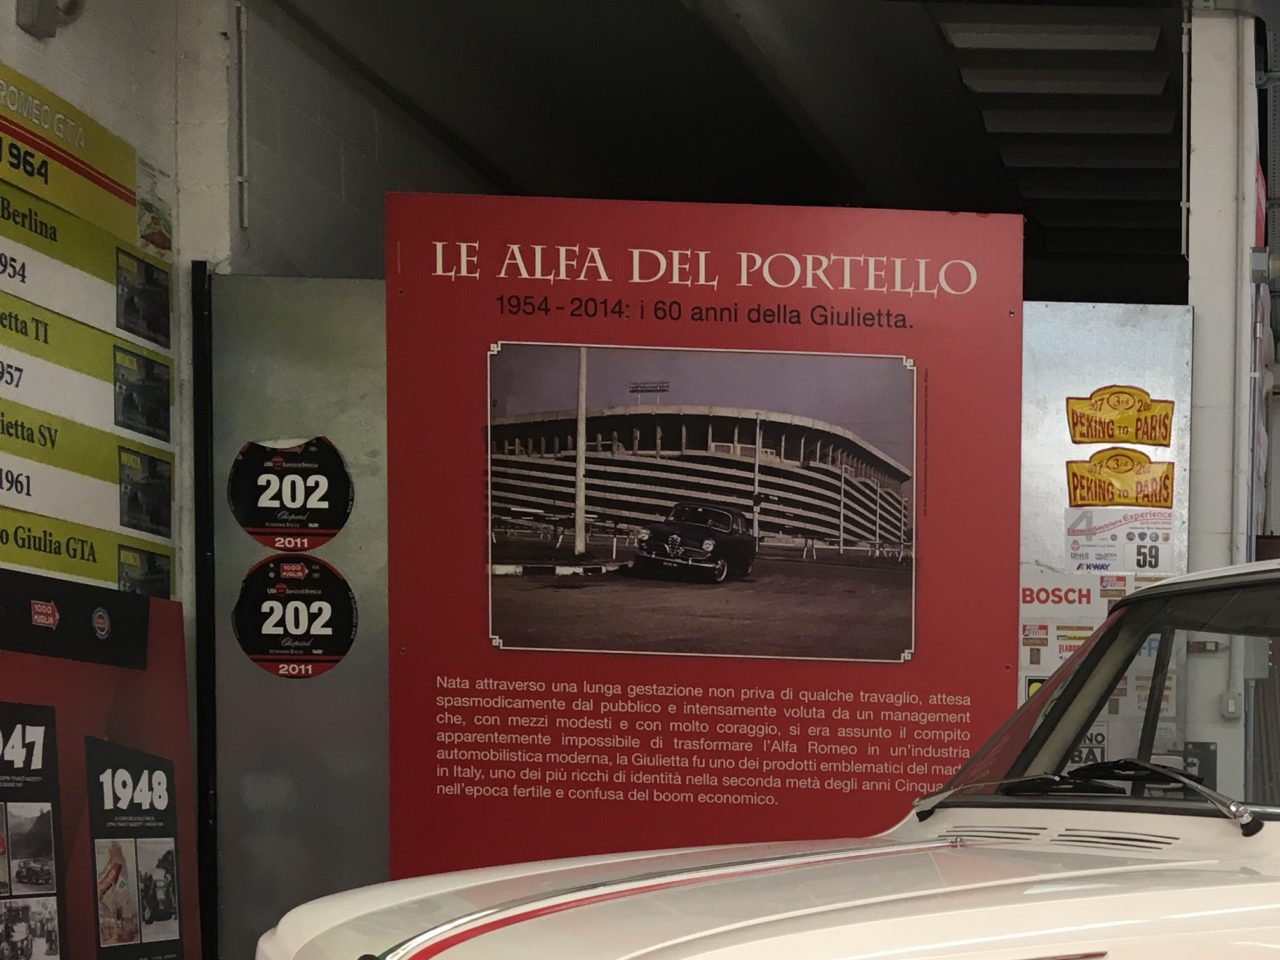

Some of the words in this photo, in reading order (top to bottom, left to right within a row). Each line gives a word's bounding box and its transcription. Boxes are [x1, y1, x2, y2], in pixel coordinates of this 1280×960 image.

[1, 197, 58, 242] Berlina
[0, 252, 27, 284] 954
[431, 241, 480, 281] LE
[496, 243, 612, 284] ALFA
[627, 247, 719, 290] DEL
[736, 251, 978, 299] PORTELLO
[0, 311, 28, 338] etta
[31, 316, 49, 345] TI
[497, 295, 551, 315] 1954
[570, 298, 630, 319] 2014:
[652, 302, 682, 322] 60
[691, 302, 739, 323] anni
[746, 304, 802, 326] della
[810, 307, 914, 330] Giulietta.
[0, 360, 24, 389] 57
[1114, 393, 1130, 407] 3rd
[0, 411, 35, 443] ietta
[38, 423, 58, 450] SV
[1072, 409, 1115, 441] PEKING
[1118, 425, 1129, 436] TO
[1135, 412, 1169, 442] PARIS
[257, 473, 329, 509] 202
[1072, 472, 1115, 504] PEKING
[1135, 474, 1170, 504] PARIS
[1122, 509, 1173, 523] Experience
[13, 525, 62, 557] Giulia
[65, 535, 97, 564] GTA
[274, 537, 309, 548] 2011
[1136, 545, 1159, 569] 59
[1022, 587, 1091, 604] BOSCH
[261, 600, 333, 636] 202
[278, 664, 313, 675] 2011
[436, 676, 470, 689] Nata
[475, 677, 546, 692] attraverso
[551, 681, 578, 693] una
[583, 681, 622, 697] lunga
[627, 683, 703, 698] gestazione
[709, 687, 735, 698] non
[741, 687, 775, 703] priva
[780, 687, 793, 700] di
[799, 688, 854, 704] qualche
[860, 690, 923, 706] travaglio,
[928, 693, 971, 706] attesa
[436, 695, 567, 711] spasmodicamente
[572, 698, 594, 711] dal
[600, 699, 662, 714] pubblico
[667, 703, 677, 713] e
[683, 700, 777, 717] intensamente
[784, 705, 825, 719] voluta
[832, 707, 850, 720] da
[857, 710, 874, 720] un
[880, 710, 971, 725] management
[436, 711, 466, 726] che,
[474, 715, 501, 726] con
[508, 714, 549, 728] mezzi
[556, 716, 613, 729] modesti
[619, 720, 629, 730] e
[636, 720, 662, 731] con
[670, 718, 709, 732] molto
[716, 721, 781, 737] coraggio,
[789, 724, 801, 736] si
[808, 726, 830, 737] era
[837, 725, 893, 739] assunto
[899, 726, 906, 739] il
[914, 728, 971, 742] compito
[0, 723, 46, 770] 47
[436, 731, 552, 746] apparentemente
[561, 733, 641, 749] impossibile
[650, 736, 664, 749] di
[673, 736, 753, 752] trasformare
[808, 741, 857, 755] Romeo
[867, 743, 880, 756] in
[890, 744, 970, 759] un'industria
[436, 748, 543, 763] automobilistica
[546, 751, 613, 766] moderna,
[616, 753, 628, 765] la
[631, 754, 689, 768] Giulietta
[692, 756, 705, 768] fu
[709, 759, 735, 770] uno
[738, 757, 759, 770] dei
[763, 758, 817, 774] prodotti
[820, 760, 904, 775] emblematici
[907, 762, 928, 775] del
[931, 764, 962, 776] mad
[98, 767, 170, 813] 1948
[436, 764, 449, 777] in
[453, 765, 485, 781] Italy,
[489, 769, 516, 780] uno
[520, 768, 541, 780] dei
[546, 768, 567, 783] più
[571, 769, 609, 783] ricchi
[613, 770, 626, 783] di
[630, 770, 682, 785] identità
[686, 773, 718, 787] nella
[722, 774, 782, 788] seconda
[786, 776, 821, 789] metà
[824, 777, 858, 793] degli
[861, 779, 891, 791] anni
[895, 779, 943, 794] Cinqua
[513, 784, 551, 798] fertile
[555, 788, 565, 799] e
[568, 786, 624, 801] confusa
[628, 788, 649, 801] del
[653, 787, 694, 802] boom
[698, 791, 779, 806] economico.
